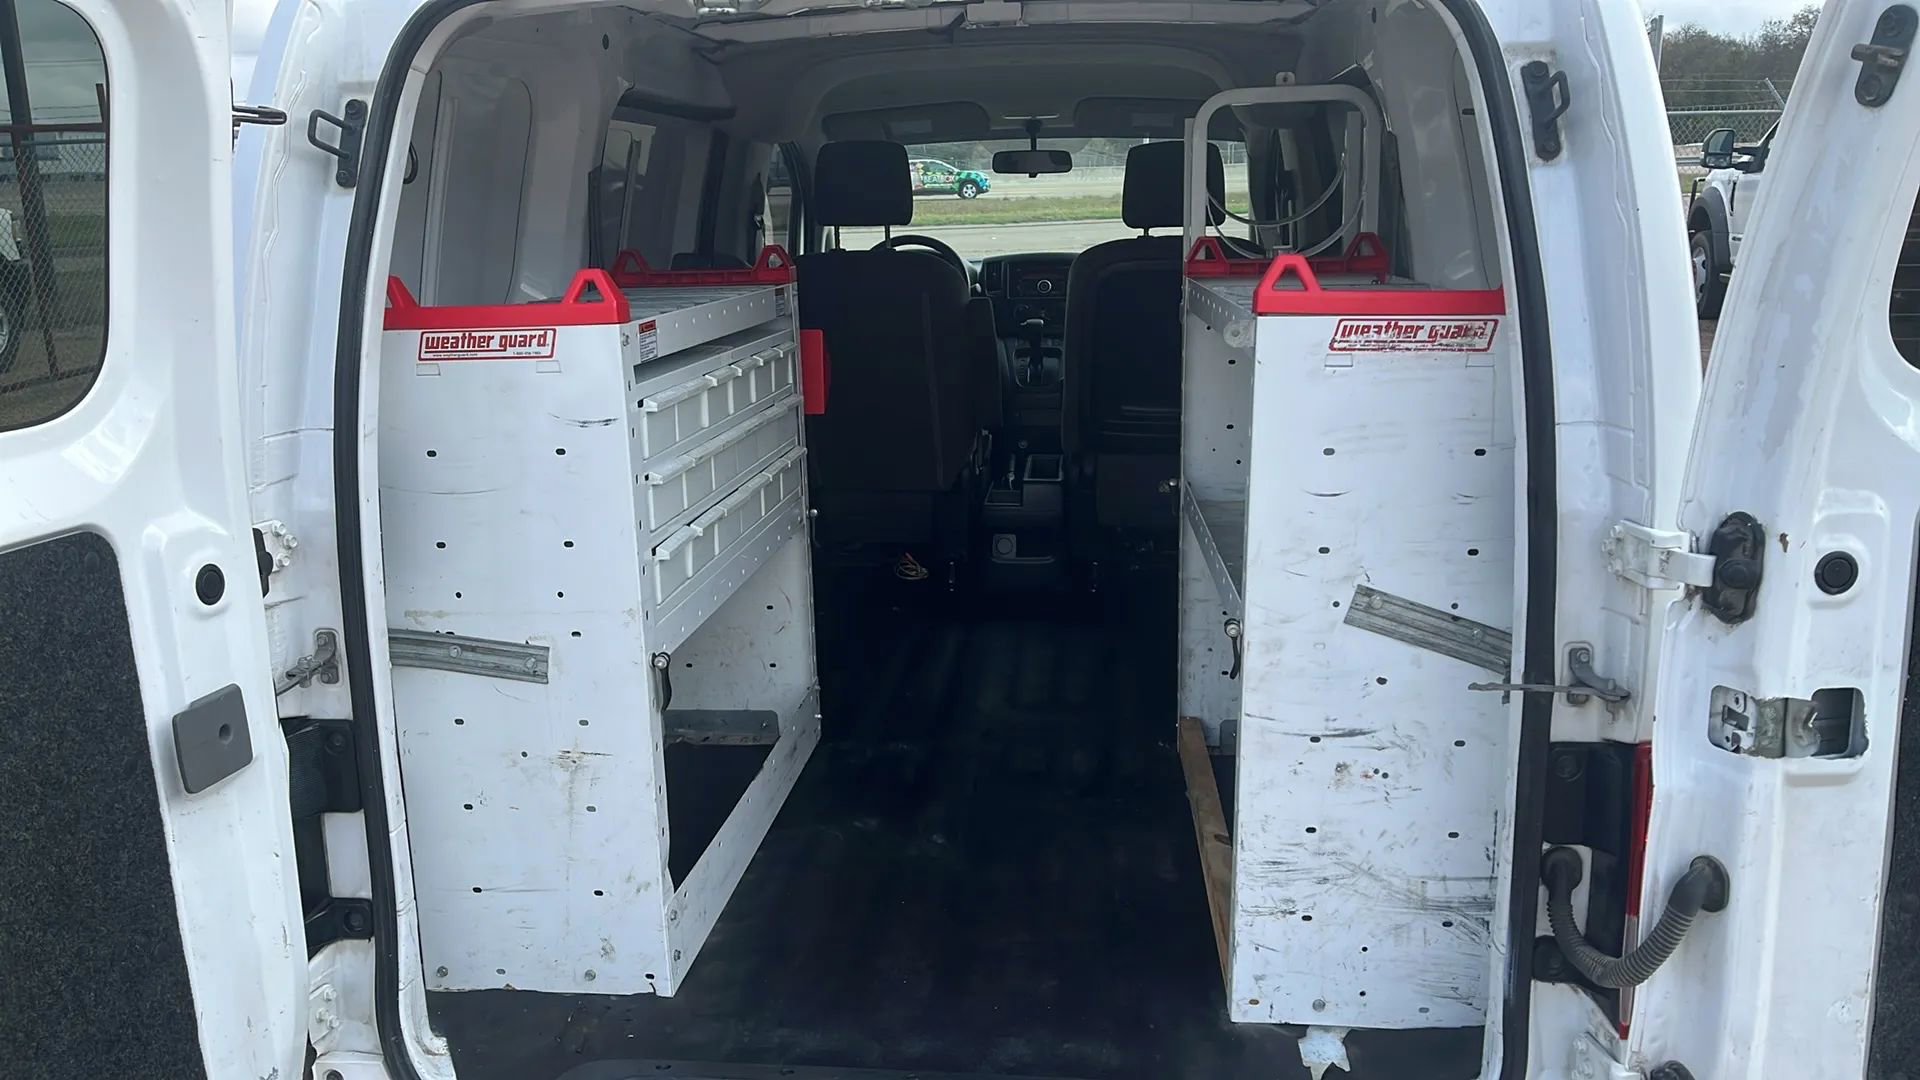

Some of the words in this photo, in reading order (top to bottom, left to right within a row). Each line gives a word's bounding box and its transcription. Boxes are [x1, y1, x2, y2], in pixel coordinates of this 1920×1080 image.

[1341, 321, 1424, 339] weather
[424, 332, 496, 350] weather
[498, 331, 548, 351] guard
